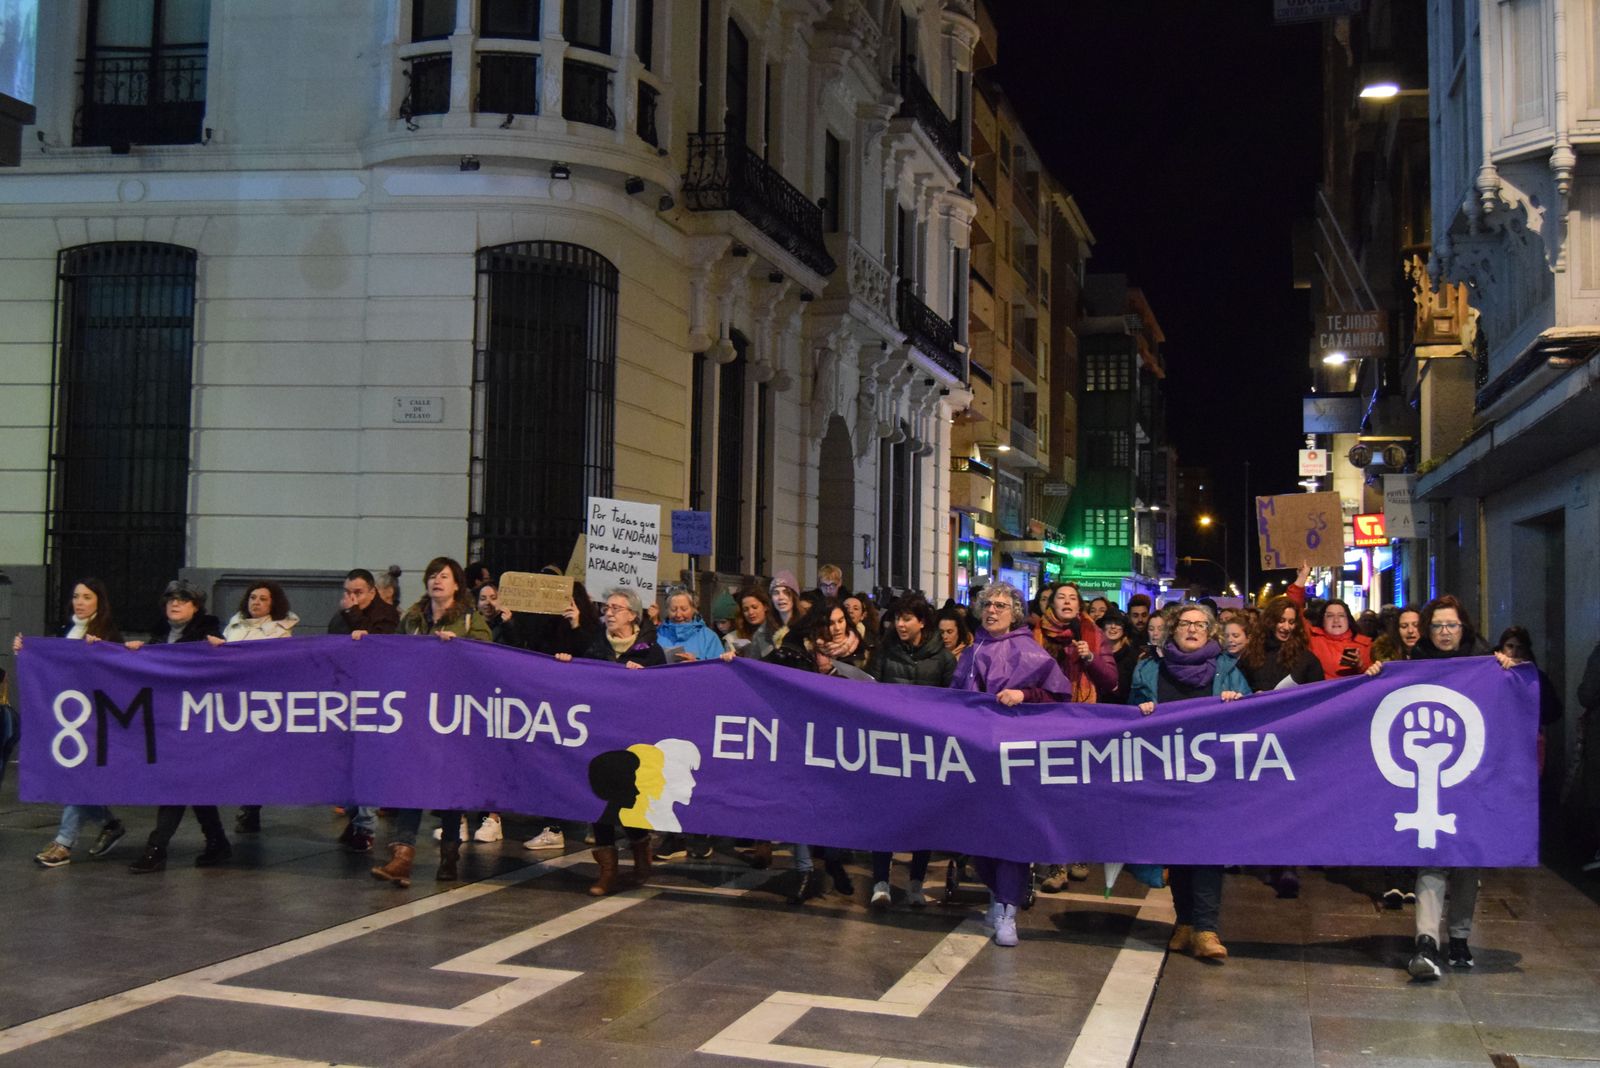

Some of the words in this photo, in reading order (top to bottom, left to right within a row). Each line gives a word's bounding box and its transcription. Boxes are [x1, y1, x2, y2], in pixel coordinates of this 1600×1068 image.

[1327, 313, 1378, 331] TEJIDOS
[592, 503, 606, 519] Por
[640, 521, 655, 534] que
[590, 523, 606, 537] NO
[589, 542, 609, 553] pues
[610, 543, 620, 554] de
[1356, 537, 1388, 545] TABACOS
[588, 556, 637, 575] APAGARON
[52, 686, 157, 768] 8M
[180, 690, 407, 734] MUJERES
[712, 715, 779, 762] EN
[804, 722, 977, 783] LUCHA
